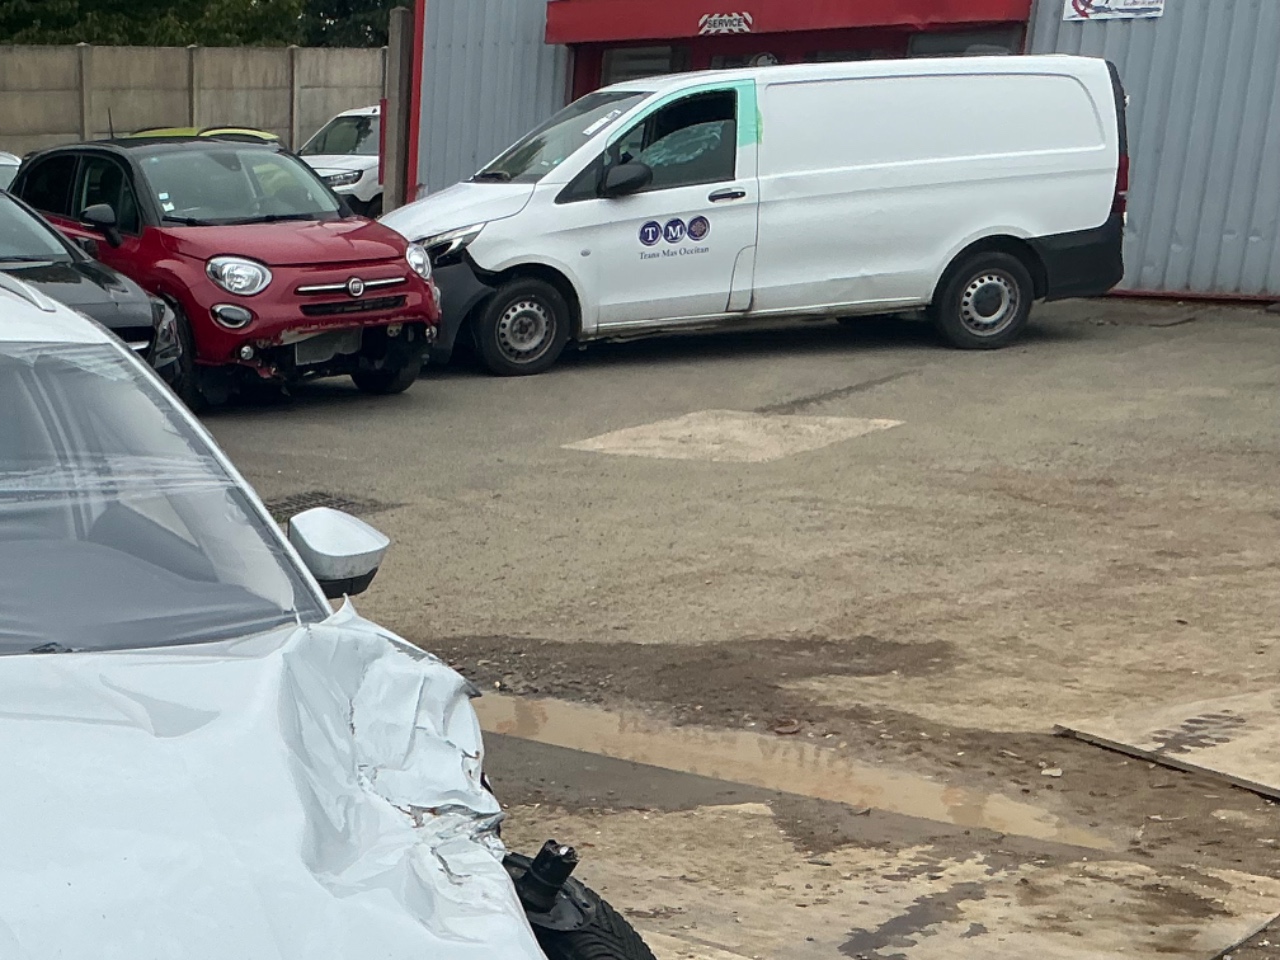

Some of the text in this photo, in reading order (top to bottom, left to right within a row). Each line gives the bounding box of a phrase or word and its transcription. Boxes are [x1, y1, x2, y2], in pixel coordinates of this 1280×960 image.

[707, 18, 743, 28] SERVICE
[639, 246, 709, 260] Trans Mas Occitan
